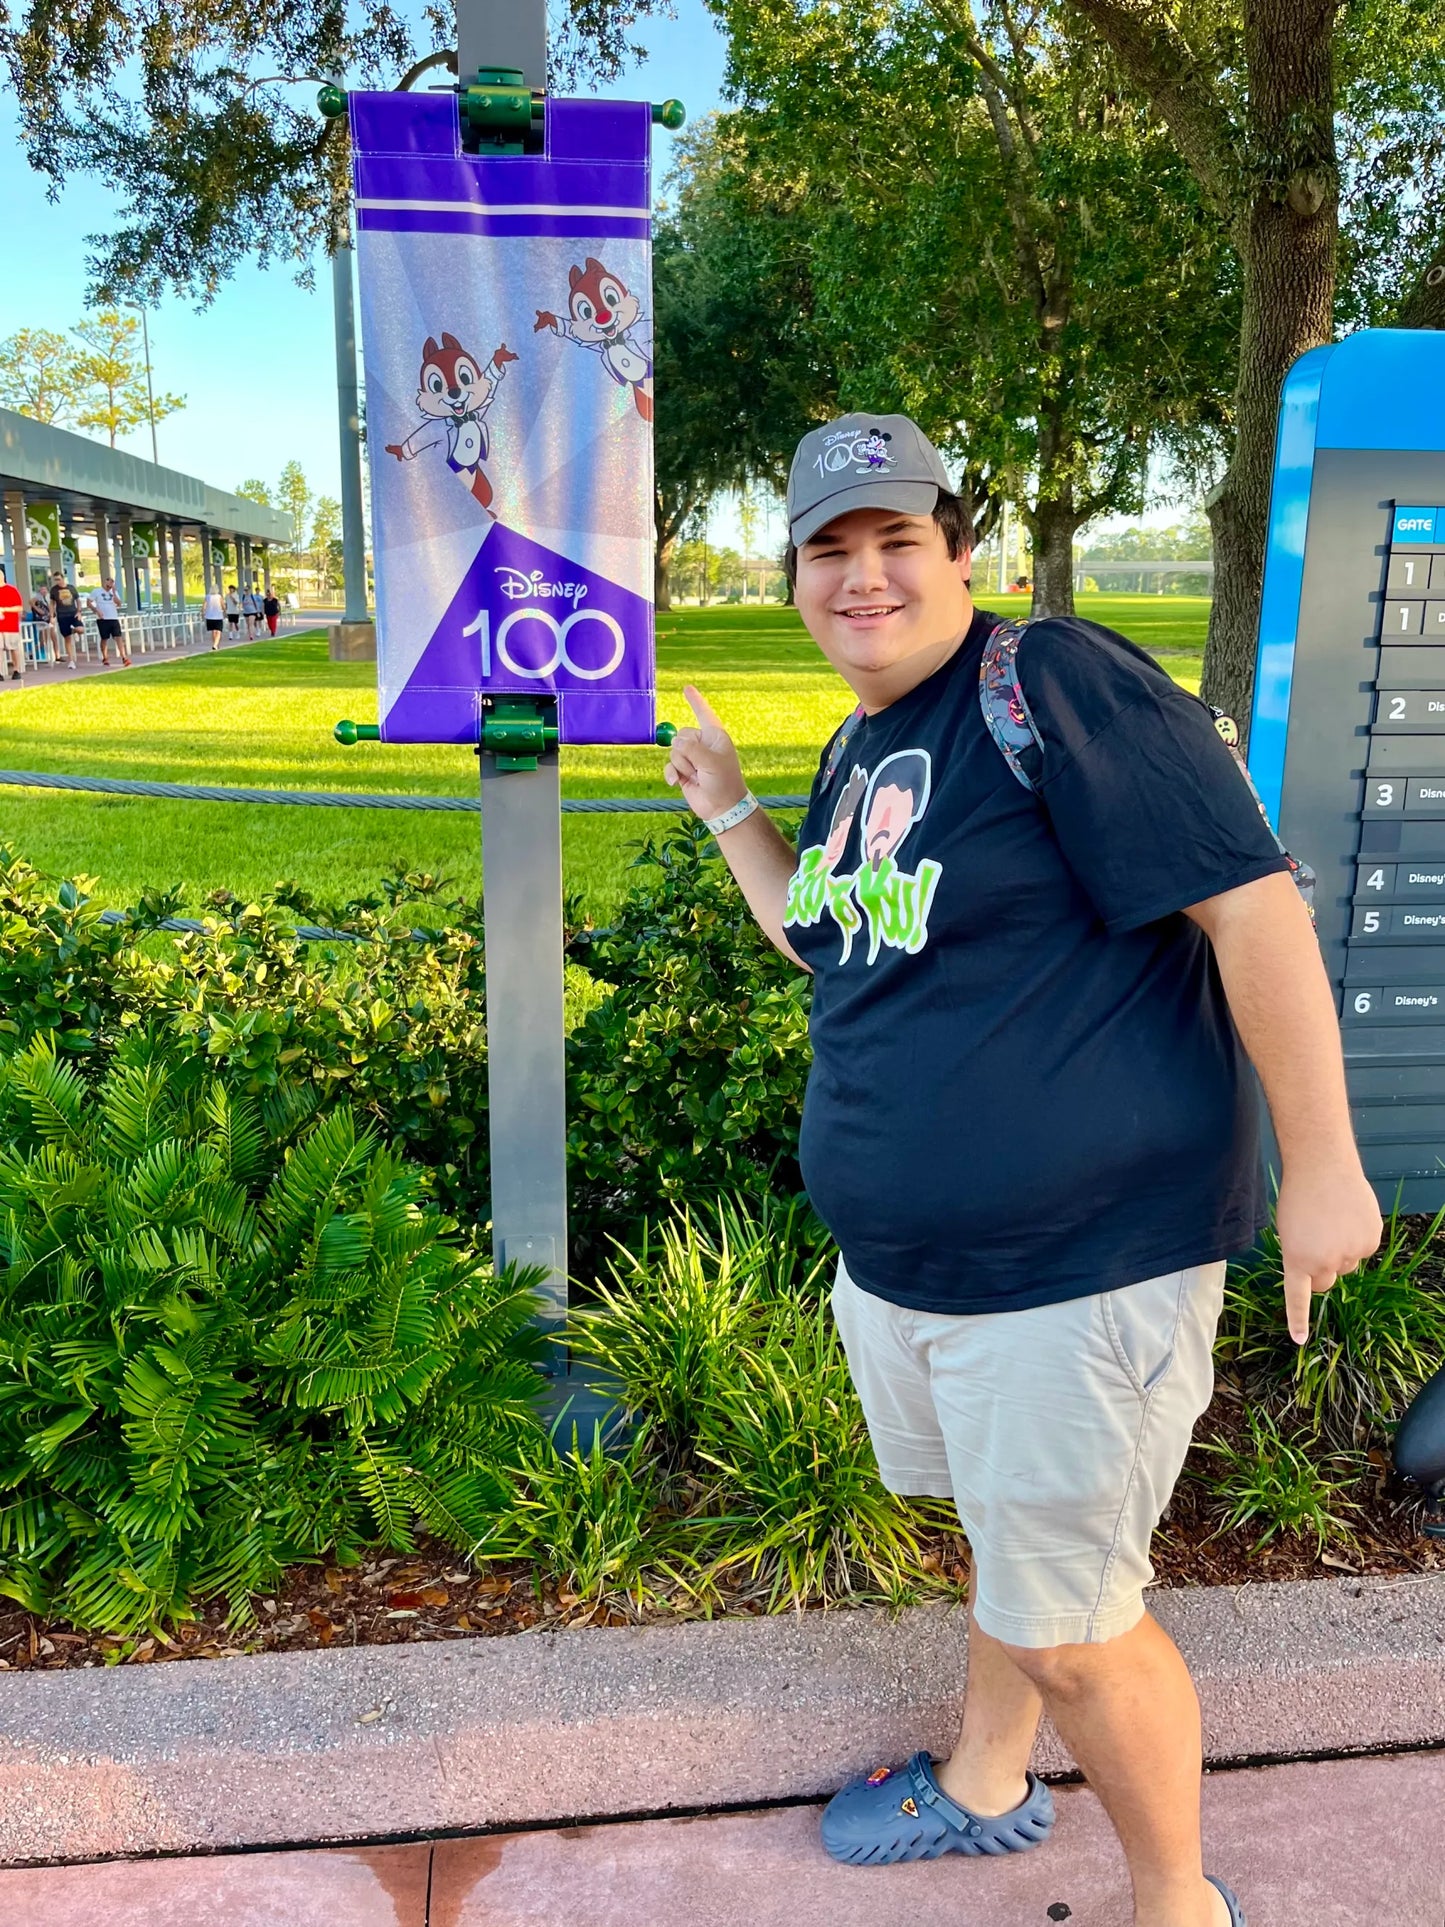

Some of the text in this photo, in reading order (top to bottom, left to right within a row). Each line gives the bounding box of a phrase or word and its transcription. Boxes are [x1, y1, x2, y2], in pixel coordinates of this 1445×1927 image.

[822, 429, 862, 446] Disney
[1397, 518, 1433, 531] GATE
[1404, 562, 1414, 585] 1
[494, 567, 588, 610] Disney
[1399, 607, 1409, 631] 1
[462, 608, 626, 681] 100
[1389, 697, 1406, 720] 2
[1376, 784, 1393, 806] 3
[1366, 869, 1385, 891] 4
[1363, 911, 1445, 933] 5 Disney's
[1354, 993, 1438, 1014] 6 Disney's
